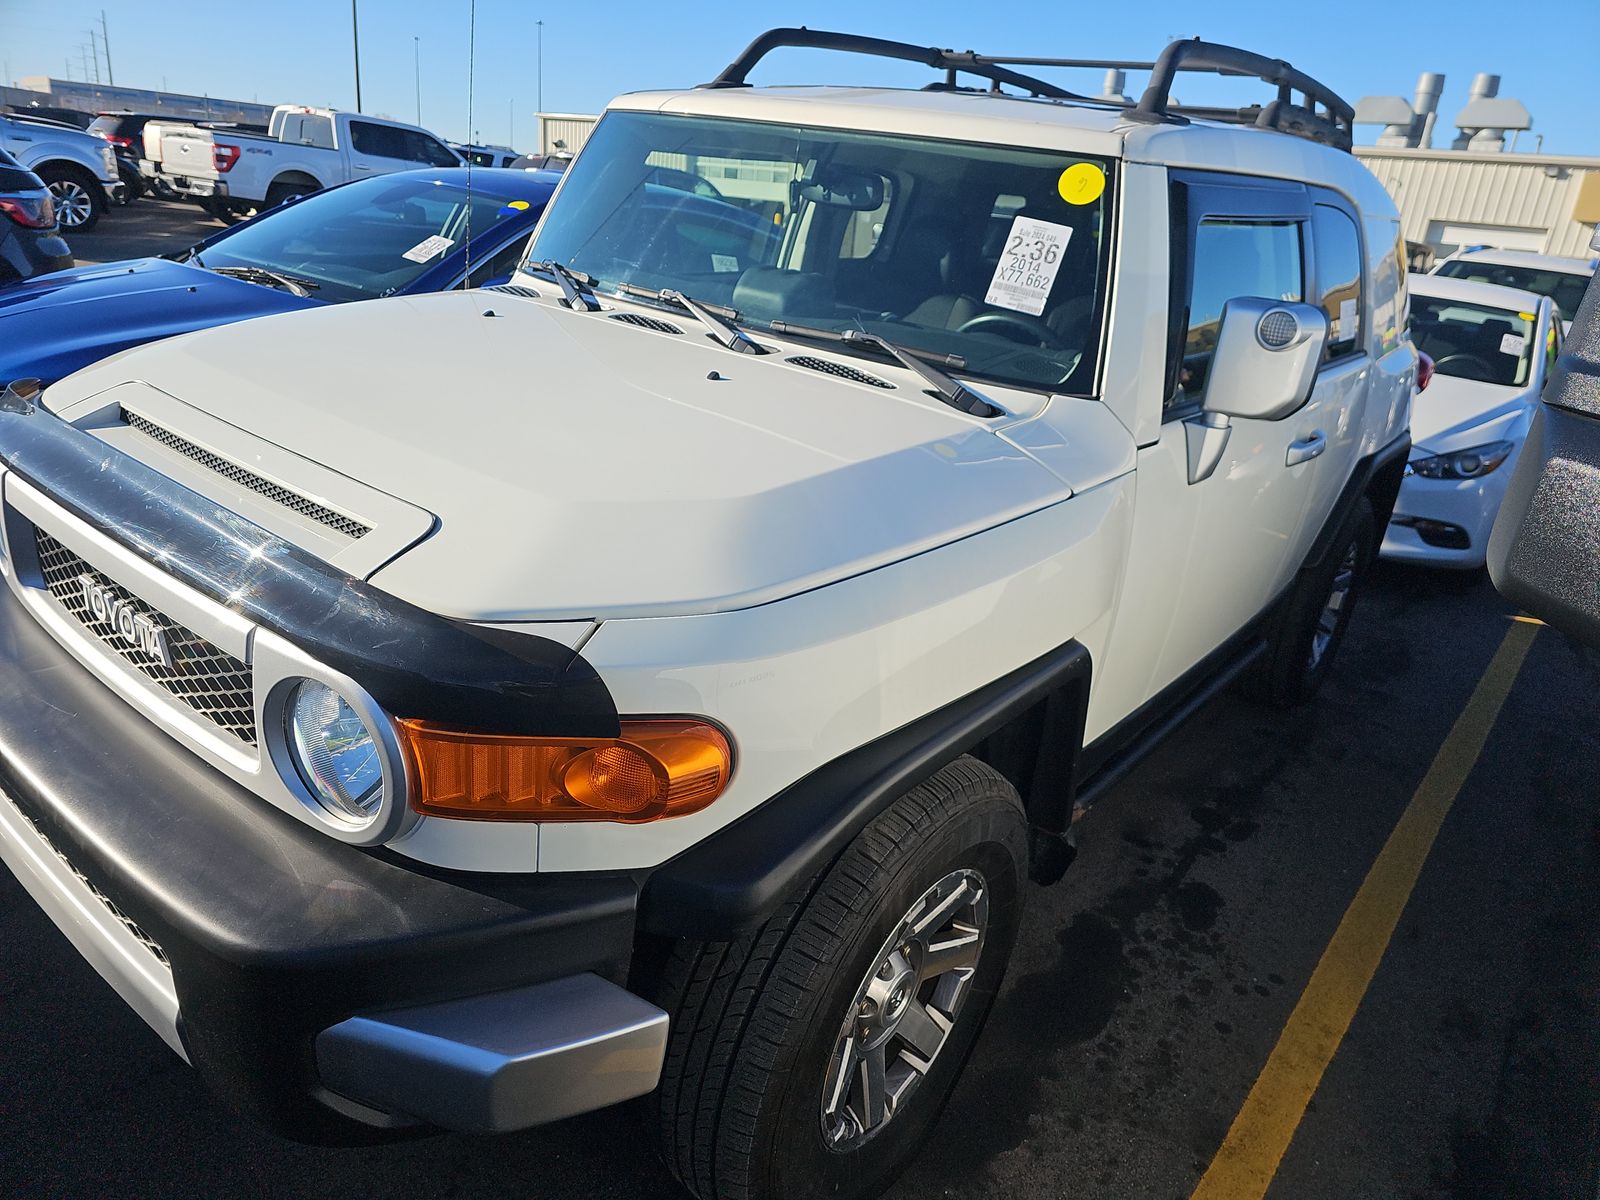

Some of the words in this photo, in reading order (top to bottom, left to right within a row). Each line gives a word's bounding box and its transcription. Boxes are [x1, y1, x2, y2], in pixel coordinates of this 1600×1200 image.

[1006, 235, 1060, 264] 2:36
[997, 266, 1050, 290] X77,662
[1010, 256, 1041, 274] 2014
[78, 572, 173, 669] TOYOTA
